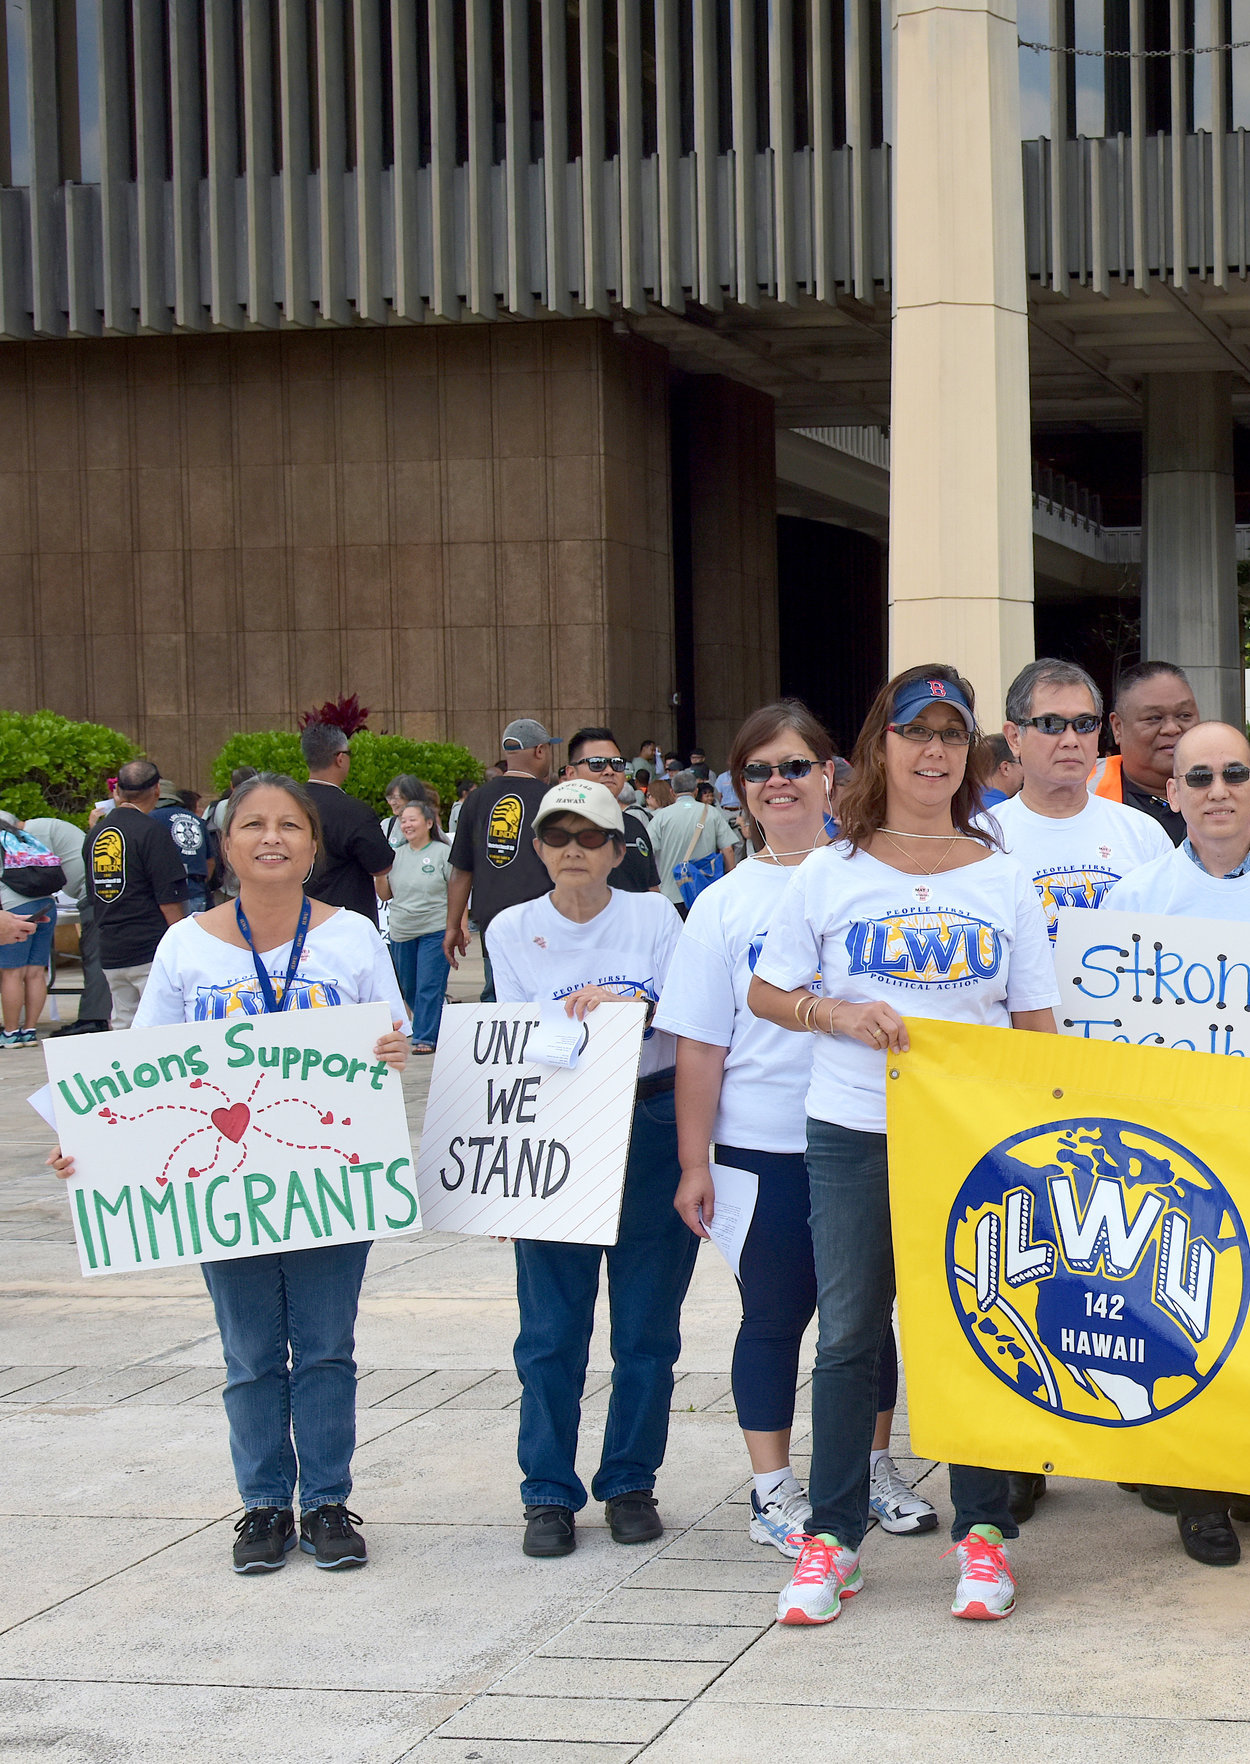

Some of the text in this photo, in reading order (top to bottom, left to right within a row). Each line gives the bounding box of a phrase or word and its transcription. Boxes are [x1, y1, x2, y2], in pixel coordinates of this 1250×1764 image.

[927, 680, 947, 697] B
[1036, 864, 1112, 875] PEOPLE FIRST
[886, 906, 971, 916] PEOPLE FIRST
[848, 918, 1005, 980] ILWU
[273, 970, 305, 979] FIST
[598, 975, 627, 984] FIRST
[870, 973, 979, 991] POLITICAL ACTION
[57, 1022, 388, 1115] Unions Support
[487, 1076, 541, 1124] WE
[440, 1136, 571, 1200] STAND
[75, 1157, 418, 1269] IMMIGRANTS
[974, 1173, 1216, 1343] ILWU
[1083, 1291, 1125, 1322] 142
[1060, 1327, 1146, 1364] HAWAII
